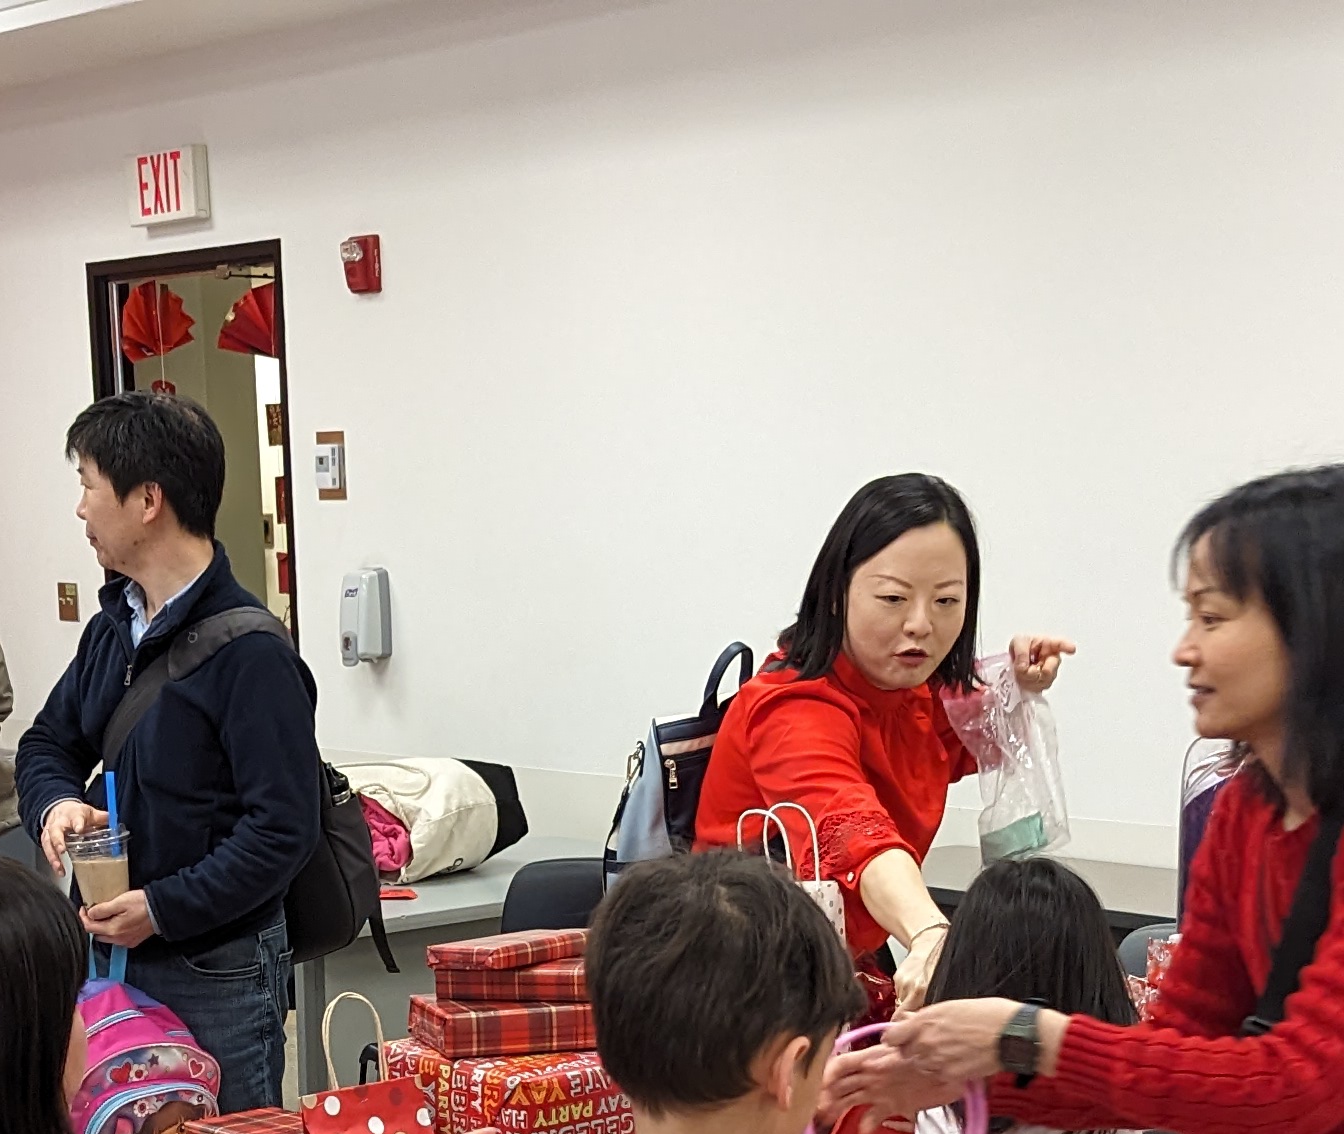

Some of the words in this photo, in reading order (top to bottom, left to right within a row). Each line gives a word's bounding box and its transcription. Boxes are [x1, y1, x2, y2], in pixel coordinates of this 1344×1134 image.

[137, 151, 181, 217] EXIT
[470, 1067, 485, 1115] RTY
[533, 1099, 593, 1128] PARTY
